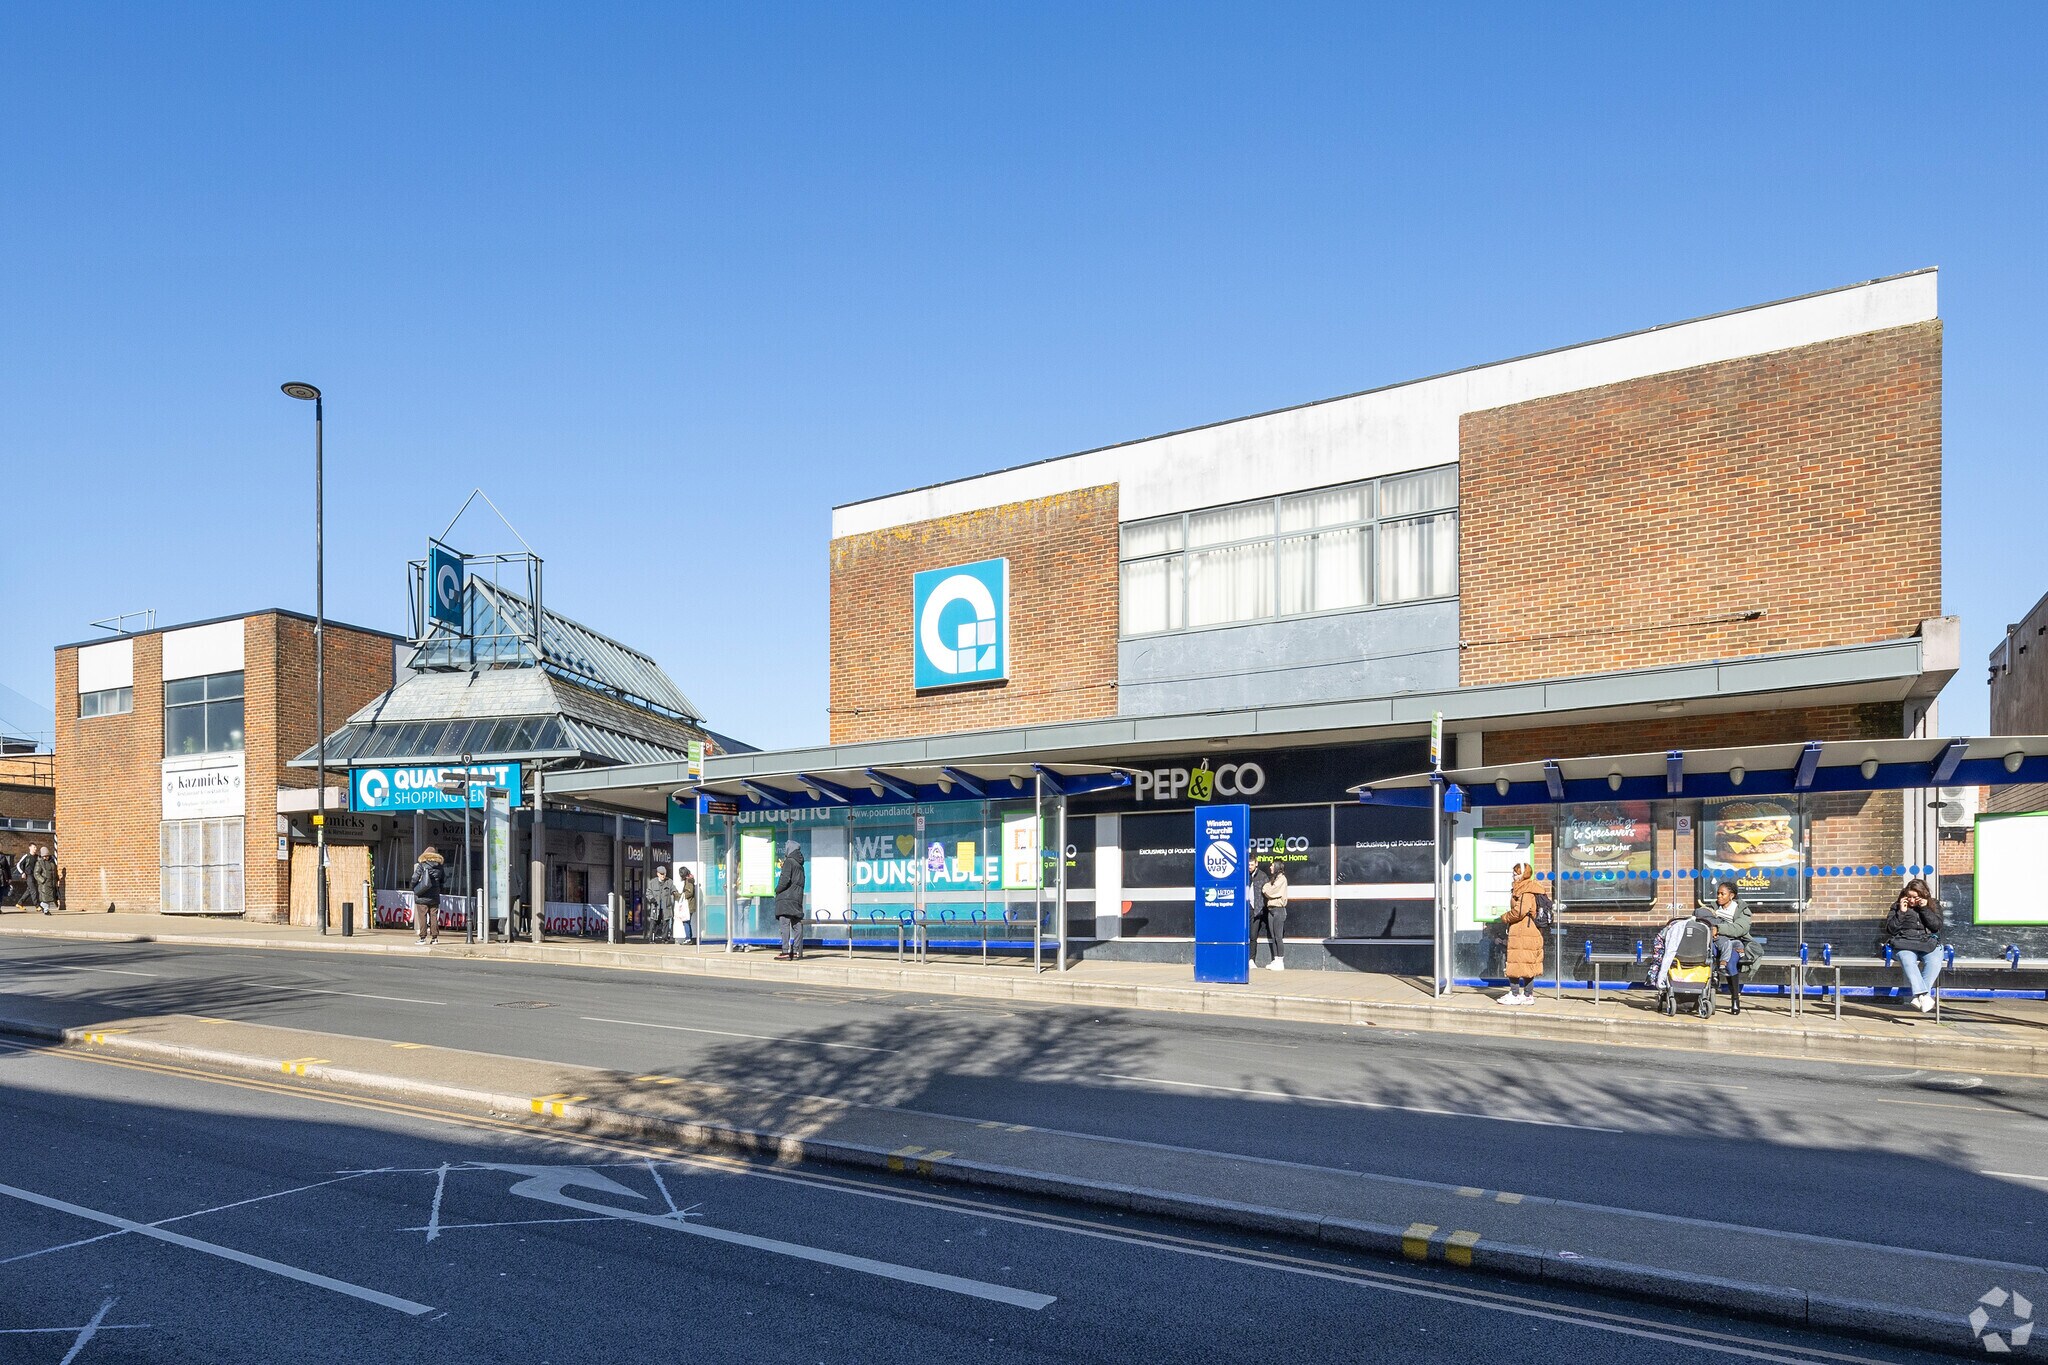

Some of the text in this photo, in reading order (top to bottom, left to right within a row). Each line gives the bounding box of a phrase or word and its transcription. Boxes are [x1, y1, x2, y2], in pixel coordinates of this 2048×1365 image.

[1136, 763, 1265, 801] PEP&CO
[709, 806, 830, 825] undland
[853, 805, 935, 819] ww.poundland.o.uk
[307, 813, 365, 828] Kzmicks
[1206, 819, 1233, 827] Winston
[442, 822, 484, 836] Kazick
[1206, 827, 1233, 835] Churchill
[1573, 826, 1636, 841] to Specsavers
[856, 836, 894, 859] WE
[1139, 848, 1167, 856] Exclusively
[1356, 841, 1389, 849] Exclusively
[1577, 843, 1593, 856] They
[652, 848, 671, 863] White
[1207, 855, 1227, 866] bus
[1288, 854, 1308, 862] Home
[1207, 864, 1227, 873] way
[1736, 878, 1770, 887] Cheese
[378, 905, 412, 923] SAGR
[439, 909, 475, 928] SAGR
[545, 916, 583, 932] AGRES
